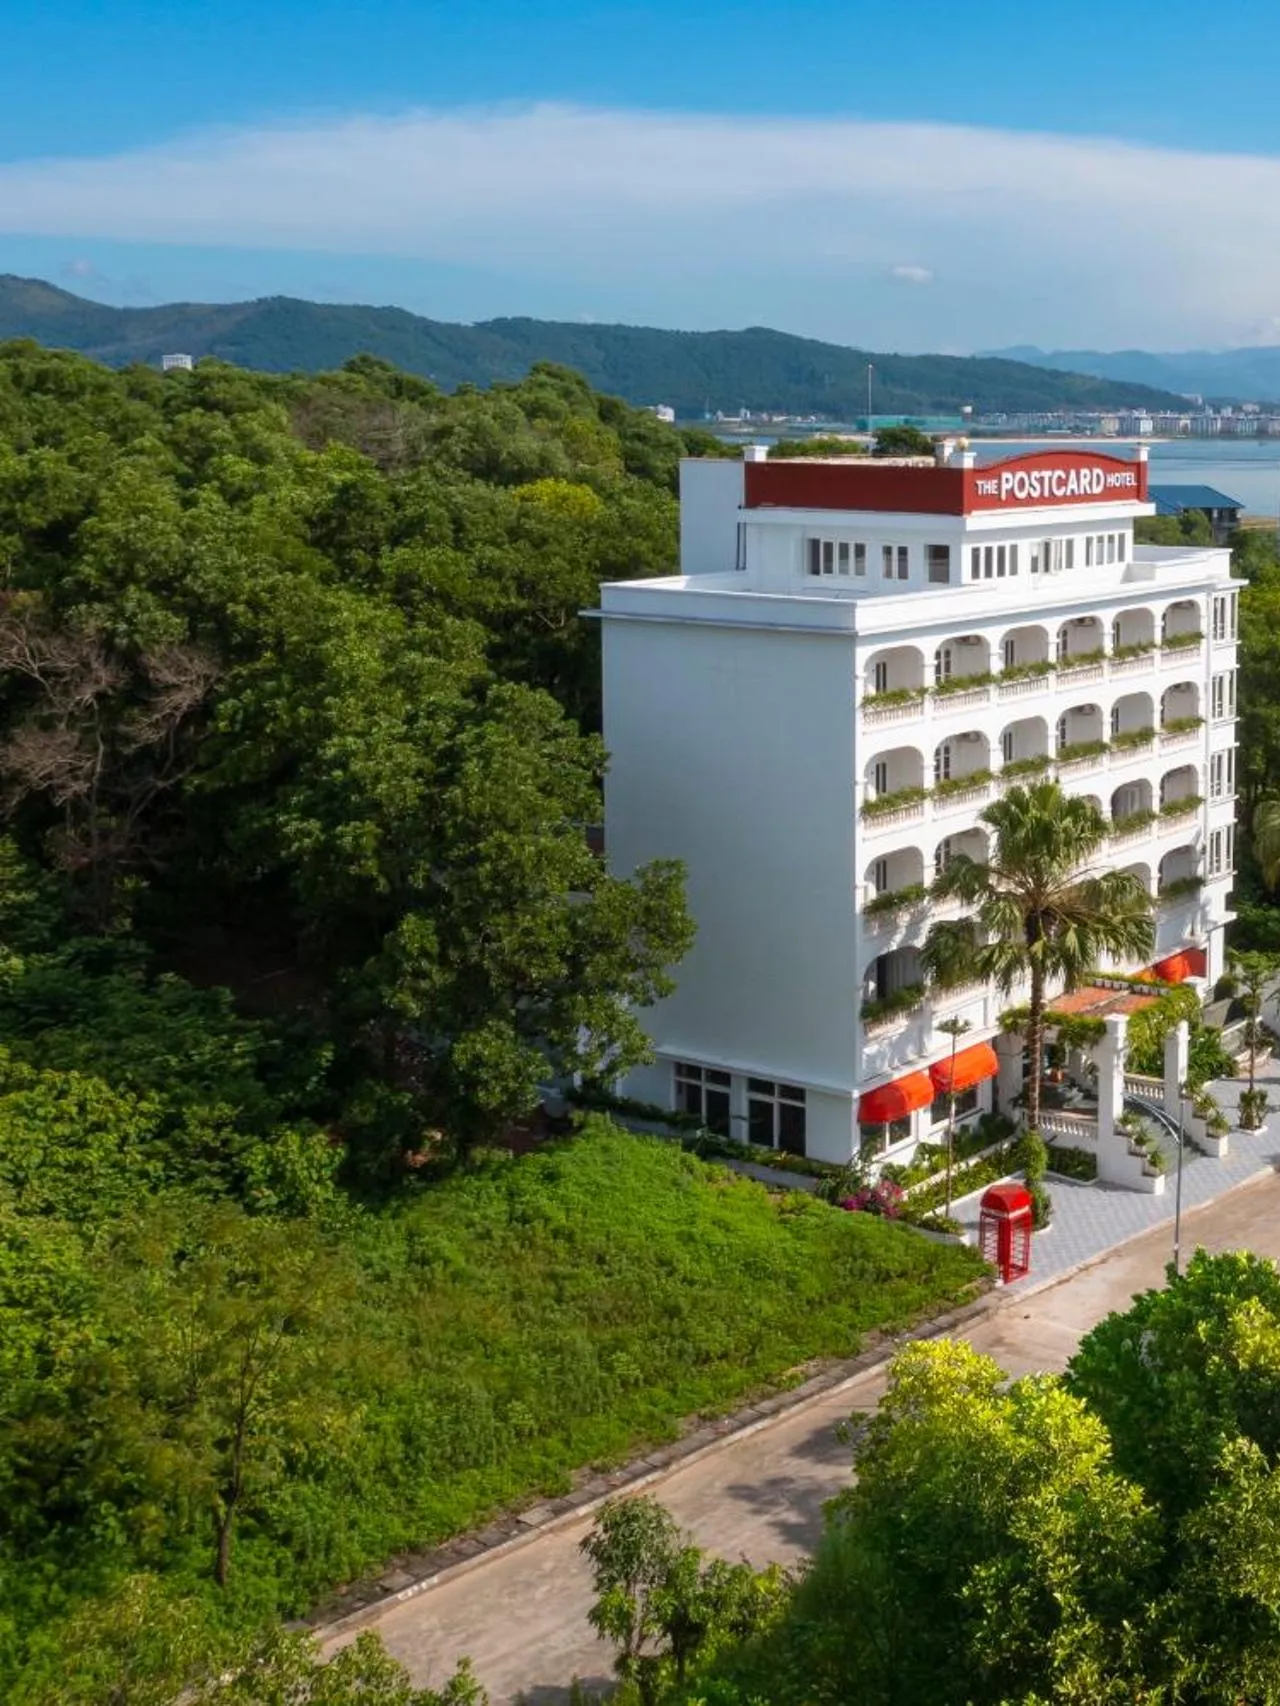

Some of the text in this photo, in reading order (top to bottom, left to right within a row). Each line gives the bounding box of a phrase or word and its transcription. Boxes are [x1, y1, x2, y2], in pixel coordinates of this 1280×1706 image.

[976, 467, 1137, 500] THE POSTCARD HOTEL
